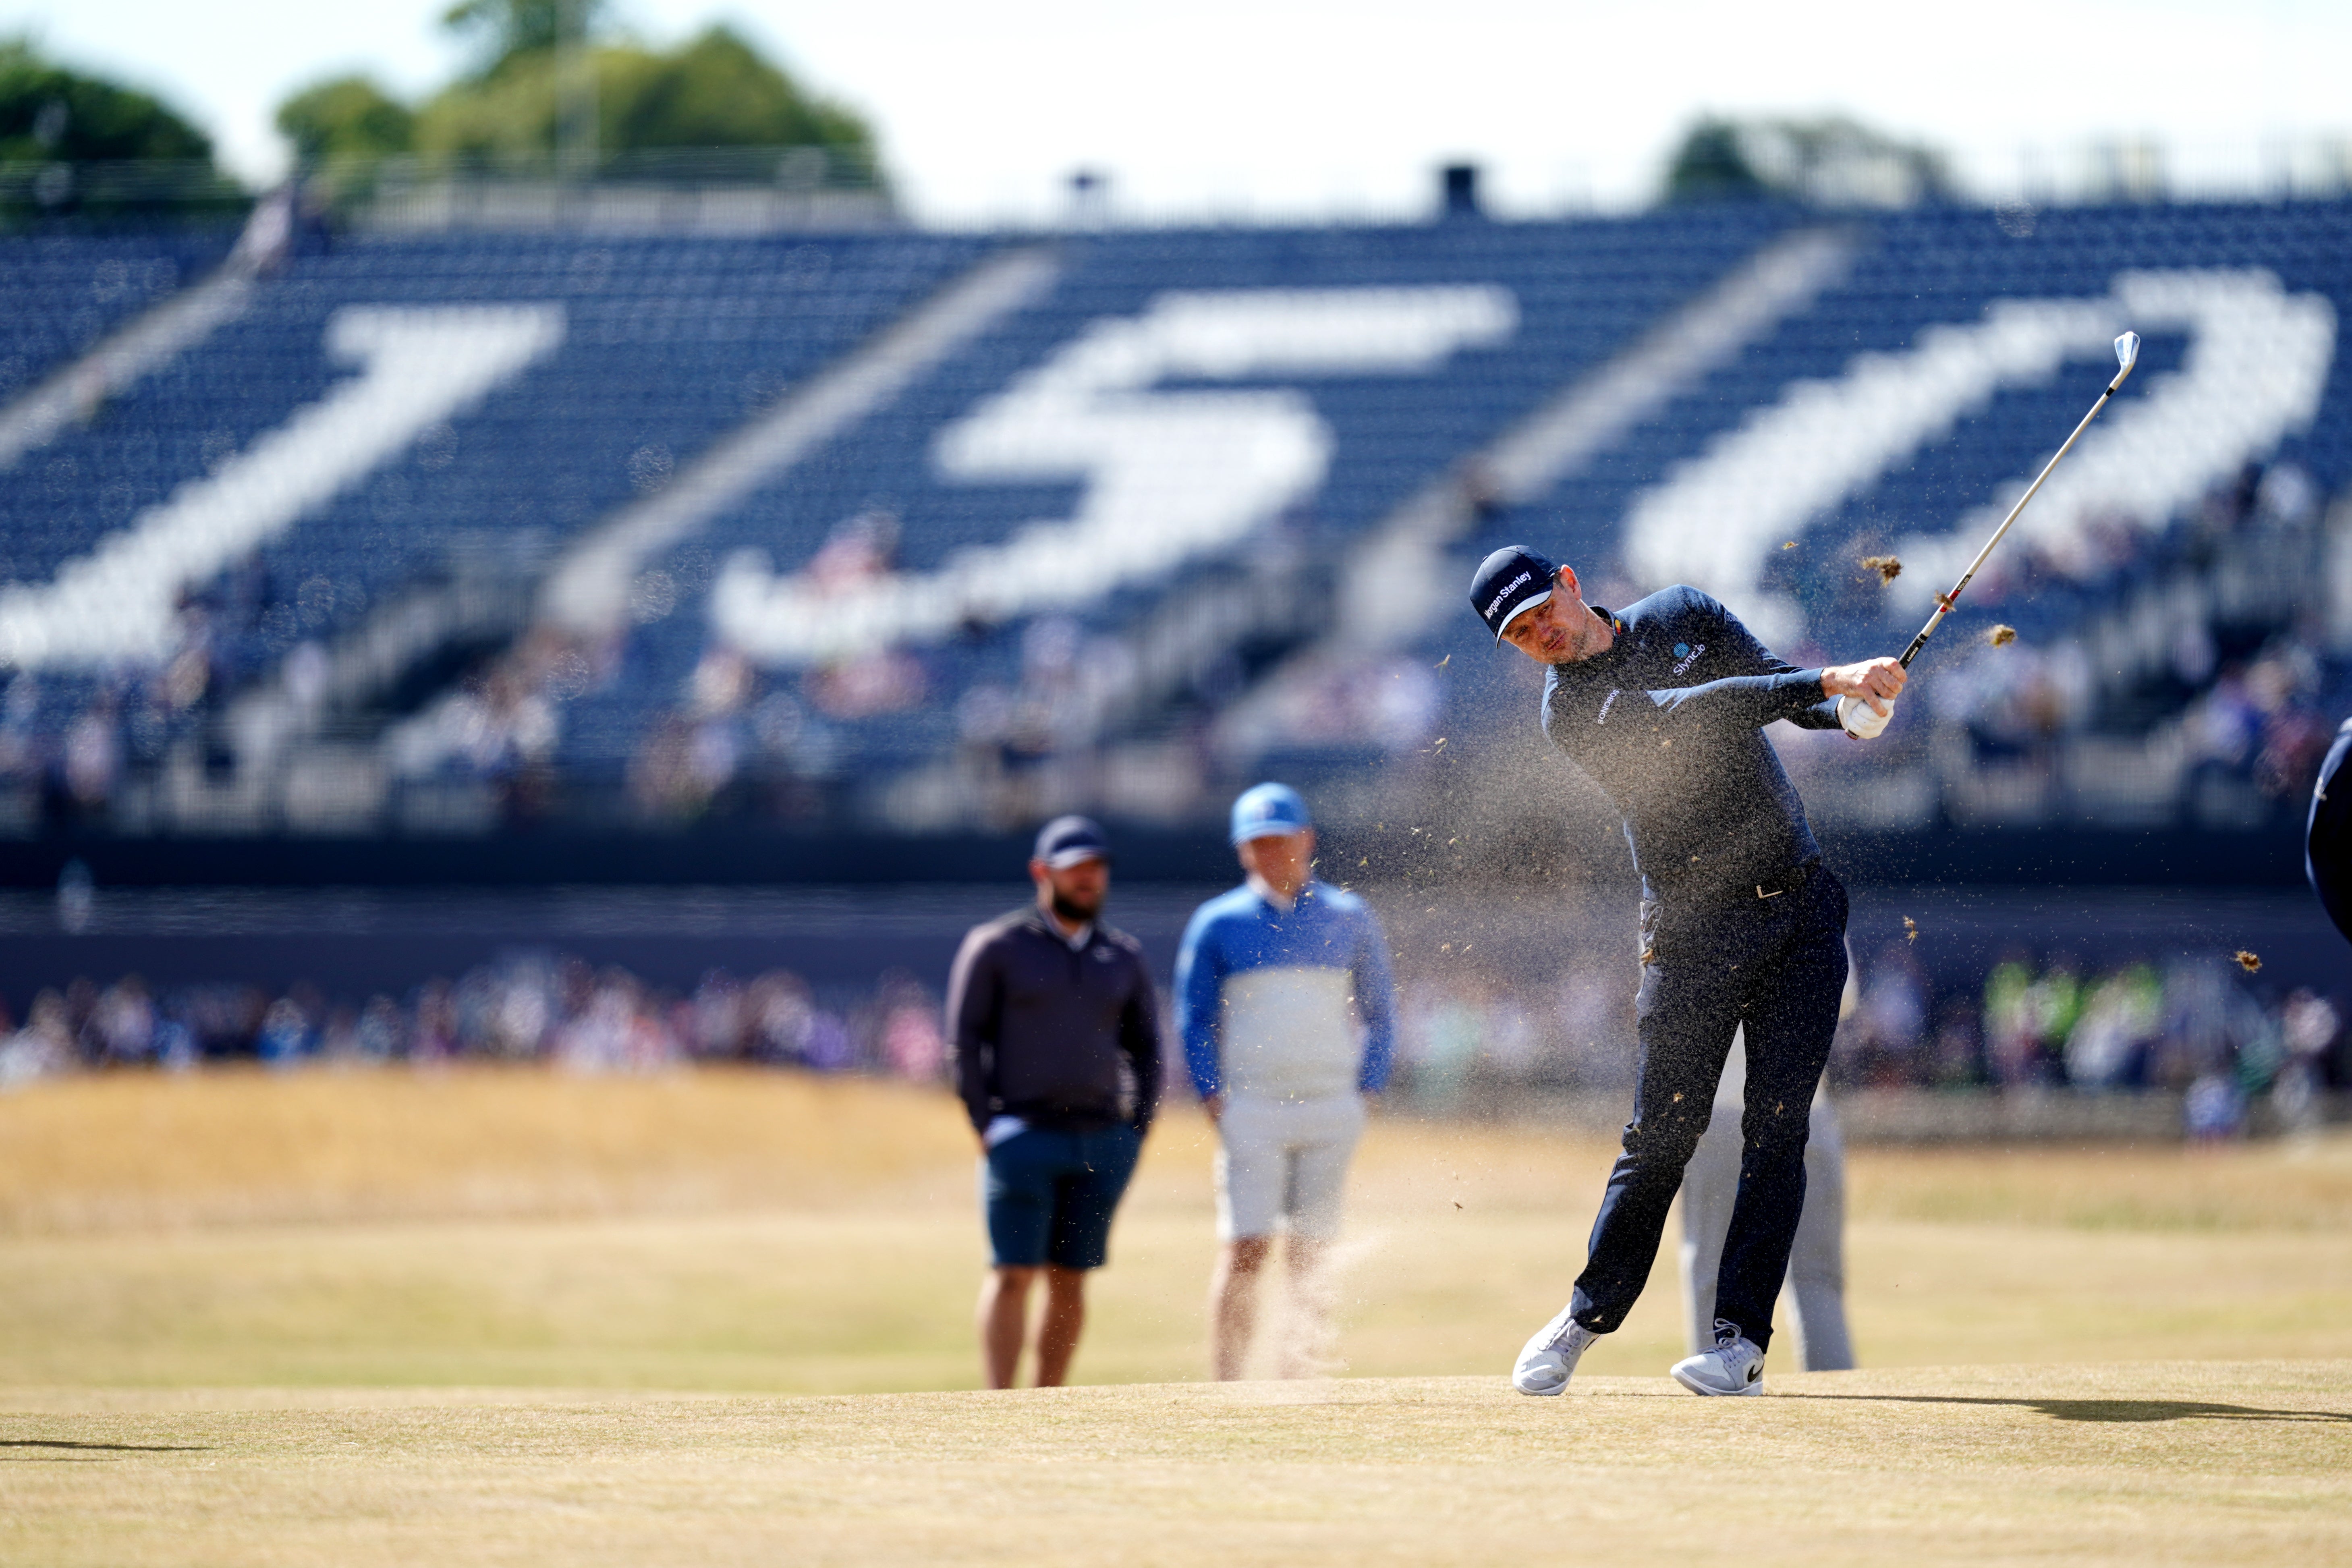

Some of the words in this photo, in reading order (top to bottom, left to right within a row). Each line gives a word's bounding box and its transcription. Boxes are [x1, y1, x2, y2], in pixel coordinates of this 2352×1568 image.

[0, 267, 2337, 669] 150
[1484, 595, 1504, 620] Morgan
[1500, 571, 1531, 598] Stanley
[1673, 644, 1705, 676] Slync.io
[1598, 689, 1620, 724] BONOBOS
